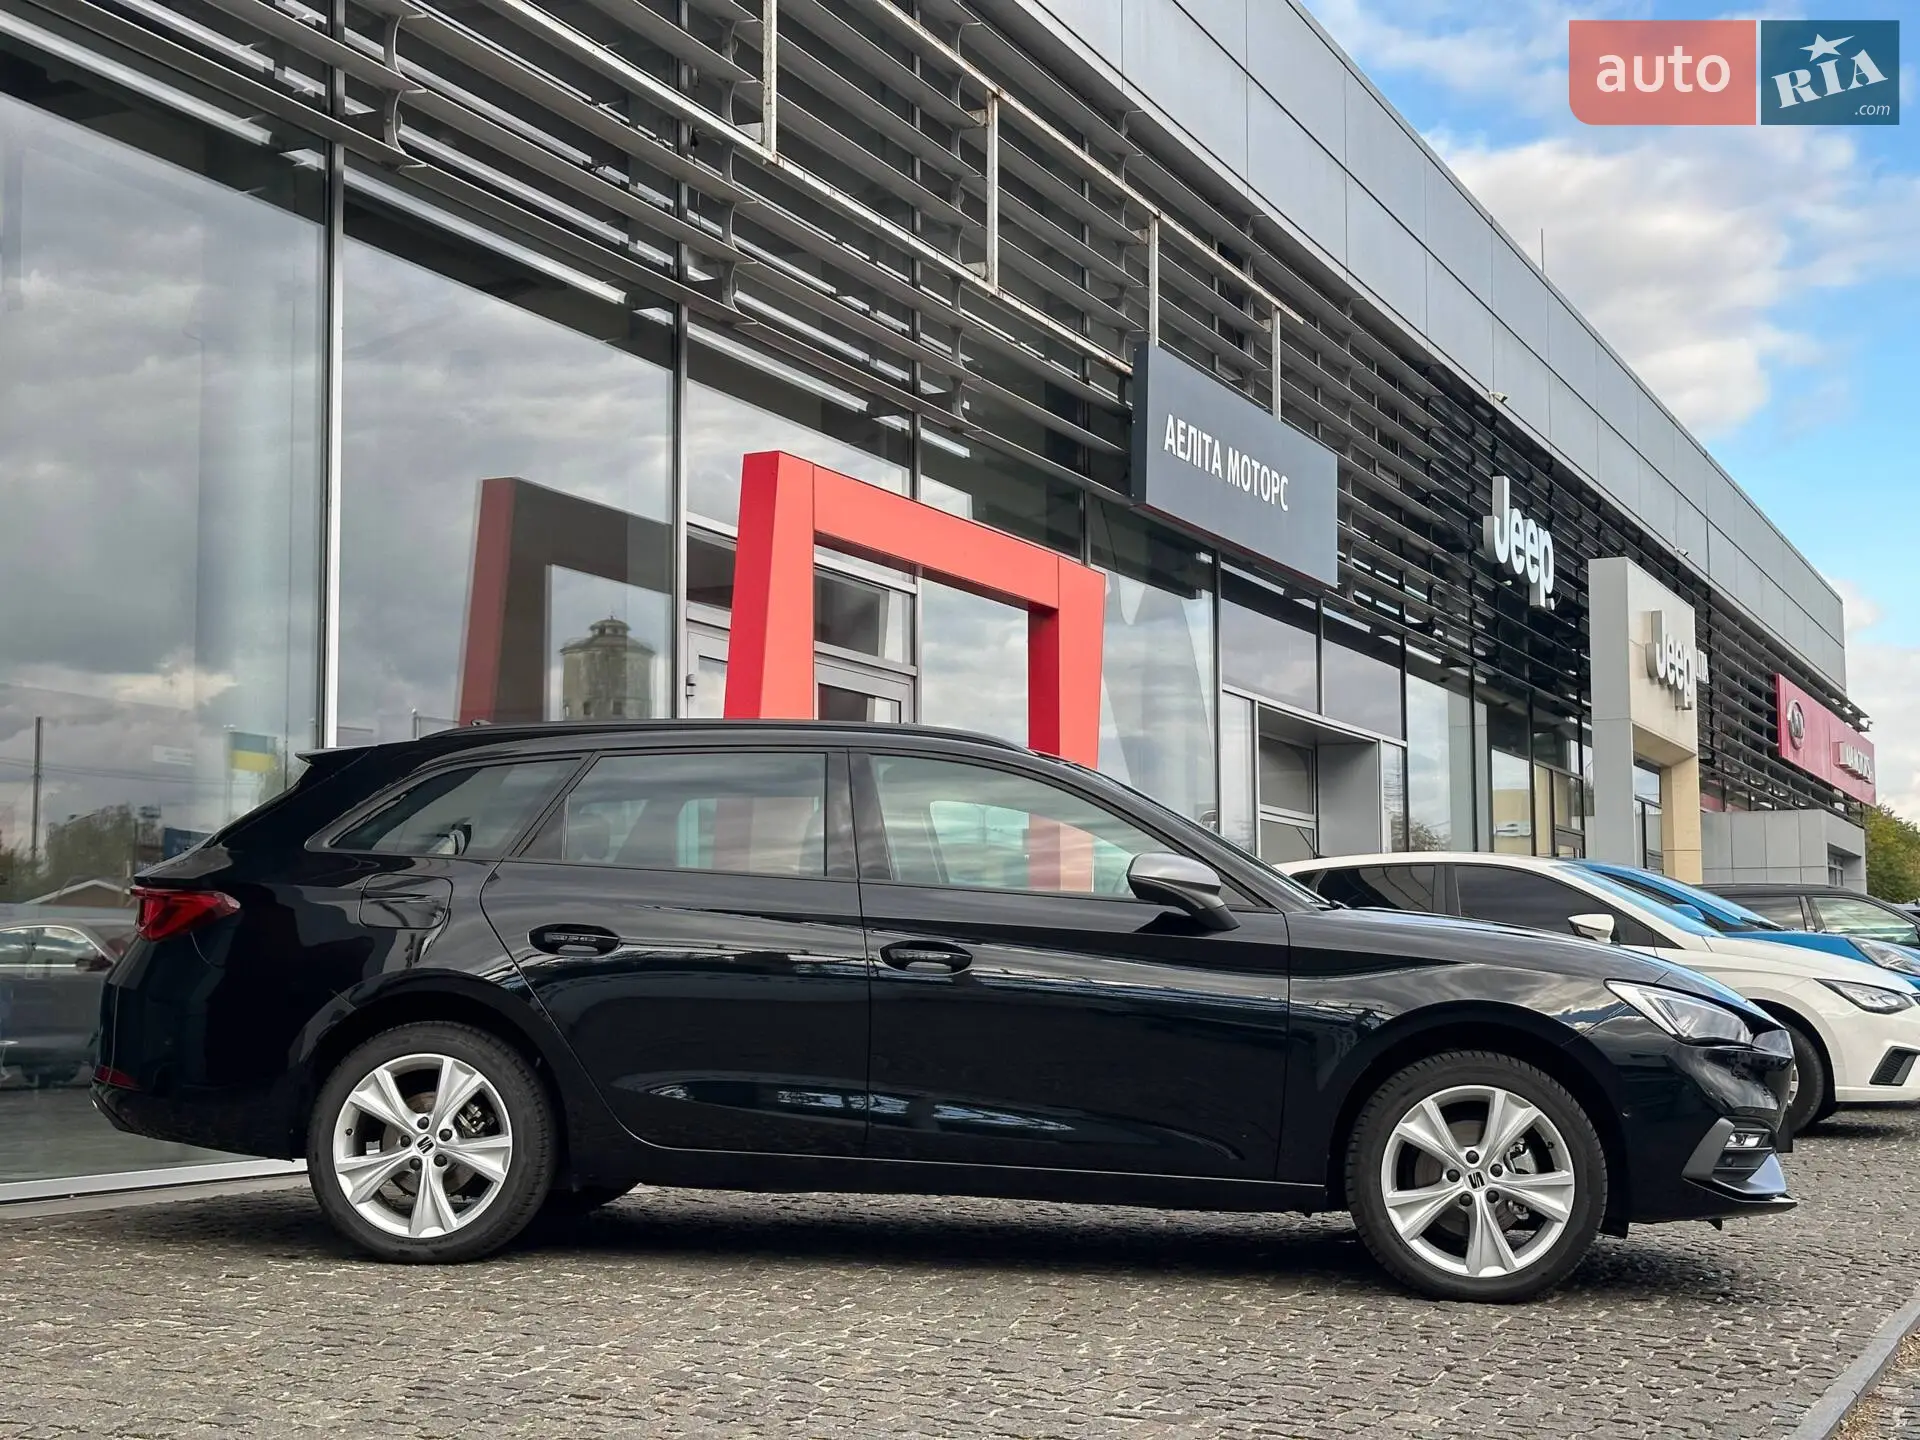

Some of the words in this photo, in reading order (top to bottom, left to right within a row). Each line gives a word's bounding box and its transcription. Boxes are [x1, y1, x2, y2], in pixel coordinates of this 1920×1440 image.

[1163, 413, 1223, 479] АЕЛІТА
[1227, 446, 1289, 512] МОТОРС
[1483, 475, 1555, 608] Jeep
[1645, 610, 1694, 708] Jeep
